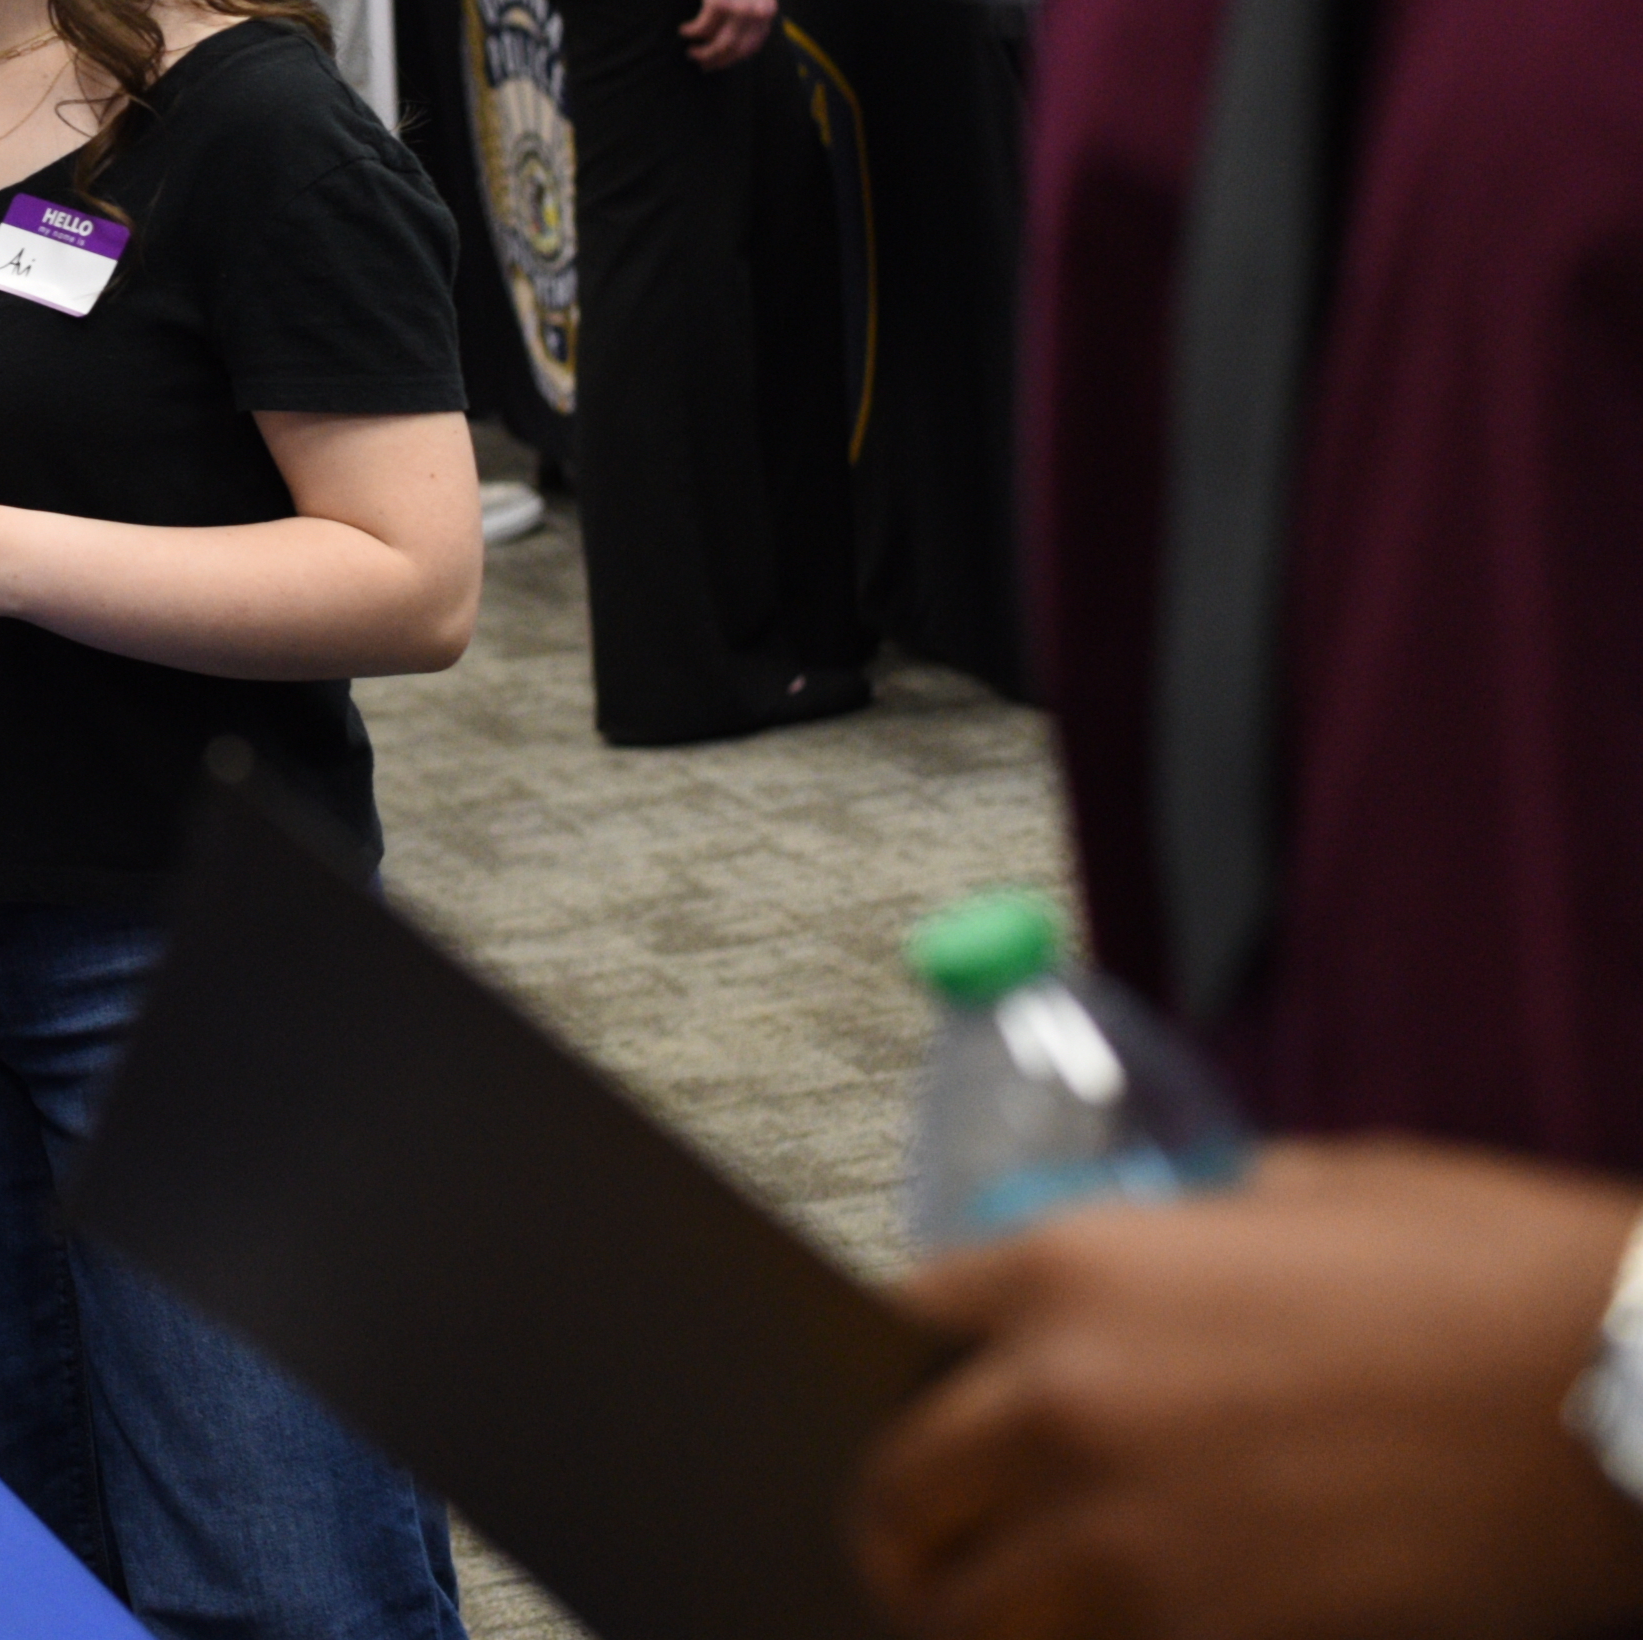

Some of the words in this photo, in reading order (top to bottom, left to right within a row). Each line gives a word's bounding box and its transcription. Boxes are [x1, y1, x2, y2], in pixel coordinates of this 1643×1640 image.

[42, 208, 93, 236] HELLO
[38, 226, 49, 235] my
[53, 231, 75, 243] name
[77, 237, 85, 246] is
